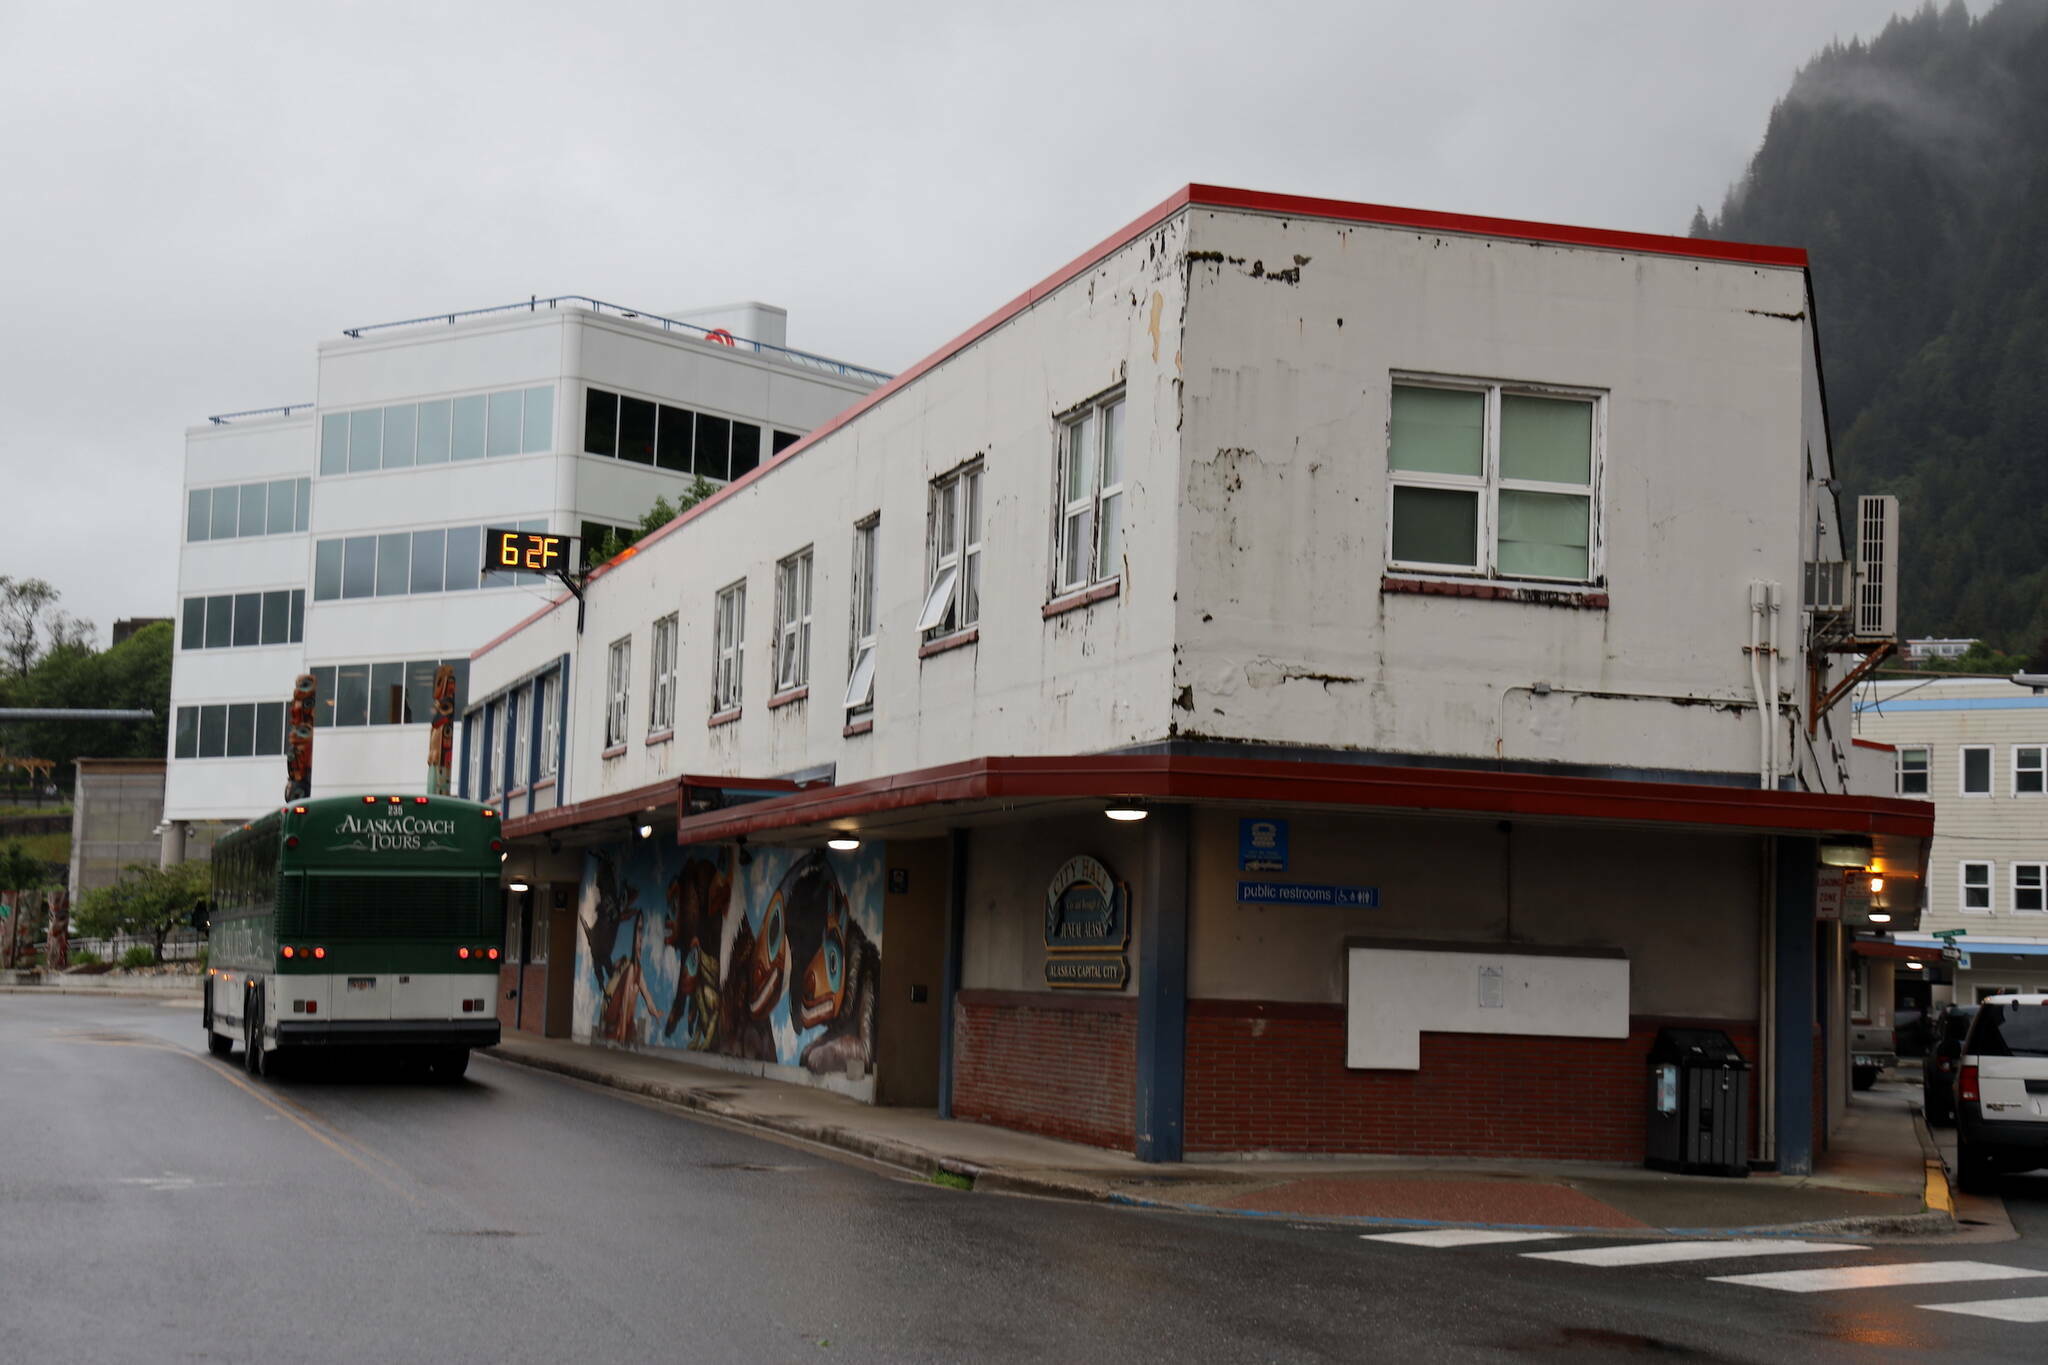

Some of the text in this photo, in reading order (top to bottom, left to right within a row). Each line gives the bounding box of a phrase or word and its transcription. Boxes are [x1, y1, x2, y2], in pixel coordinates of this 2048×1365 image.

[368, 832, 421, 852] TOURS
[1053, 859, 1108, 896] CITY HALL
[1243, 884, 1331, 901] public restrooms
[1077, 964, 1102, 979] CAPITAL
[1103, 965, 1119, 979] CITY
